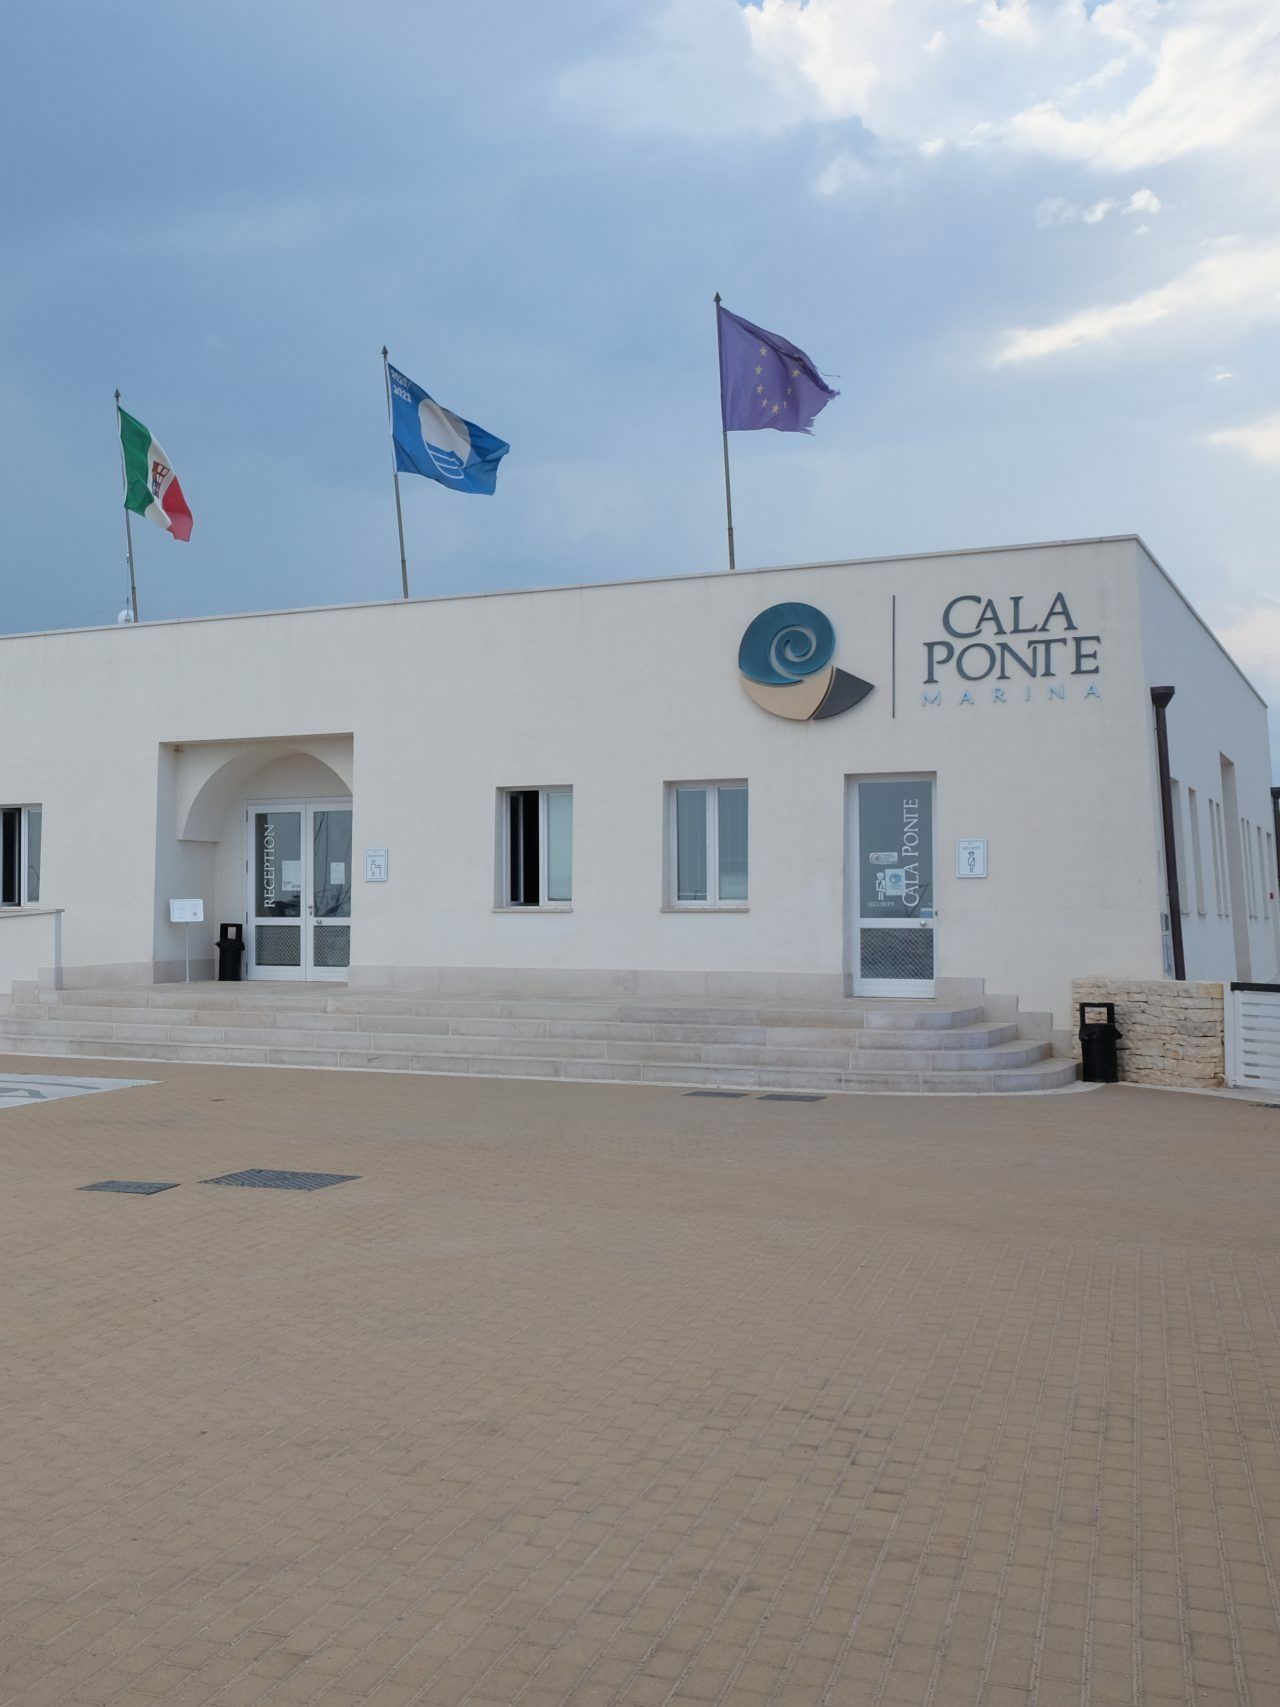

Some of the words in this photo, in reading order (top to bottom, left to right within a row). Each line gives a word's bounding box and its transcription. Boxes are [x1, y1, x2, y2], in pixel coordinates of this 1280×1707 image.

[942, 591, 1078, 639] CALA
[922, 635, 1101, 684] PONTE
[922, 682, 1101, 707] MARINA
[901, 798, 919, 857] PONTE
[263, 823, 276, 908] RECEPTION
[902, 862, 919, 907] CALA
